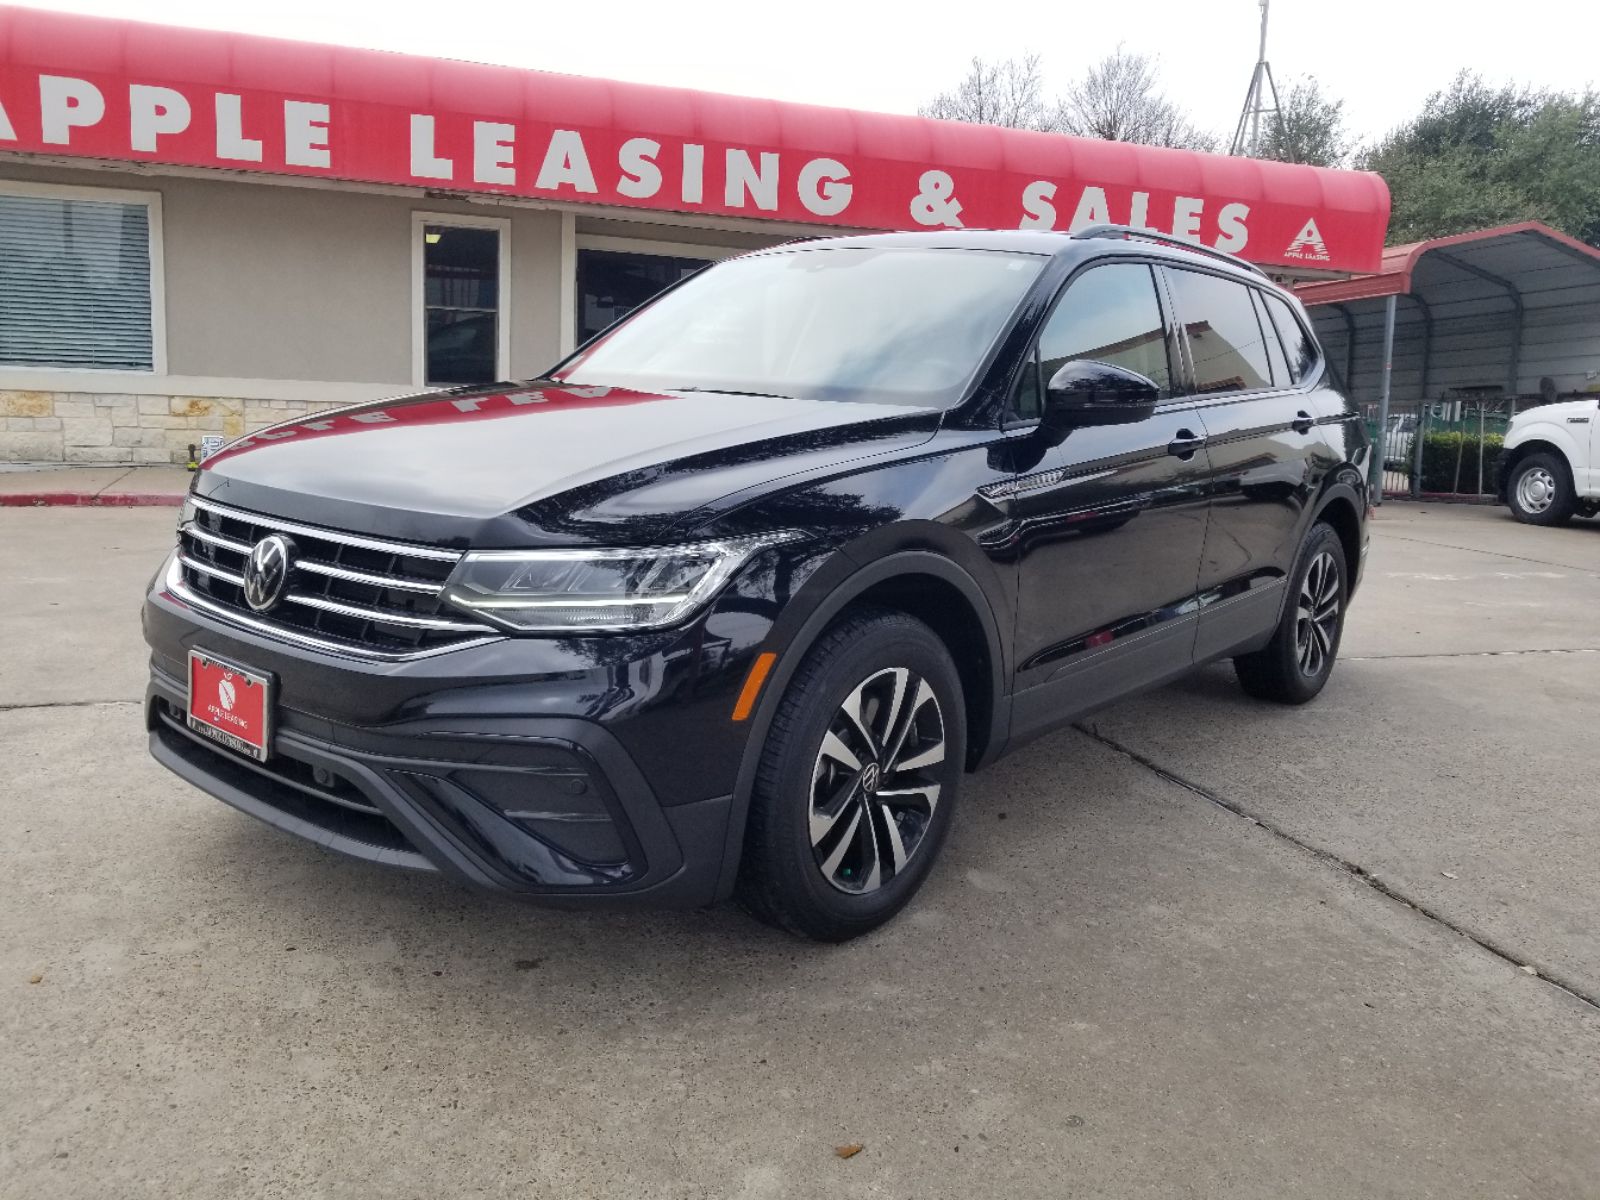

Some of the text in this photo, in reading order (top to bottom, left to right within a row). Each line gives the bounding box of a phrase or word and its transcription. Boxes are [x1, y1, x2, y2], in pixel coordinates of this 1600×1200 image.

[0, 74, 1250, 254] PPLE LEASING & SALES
[1284, 251, 1303, 259] APPLE
